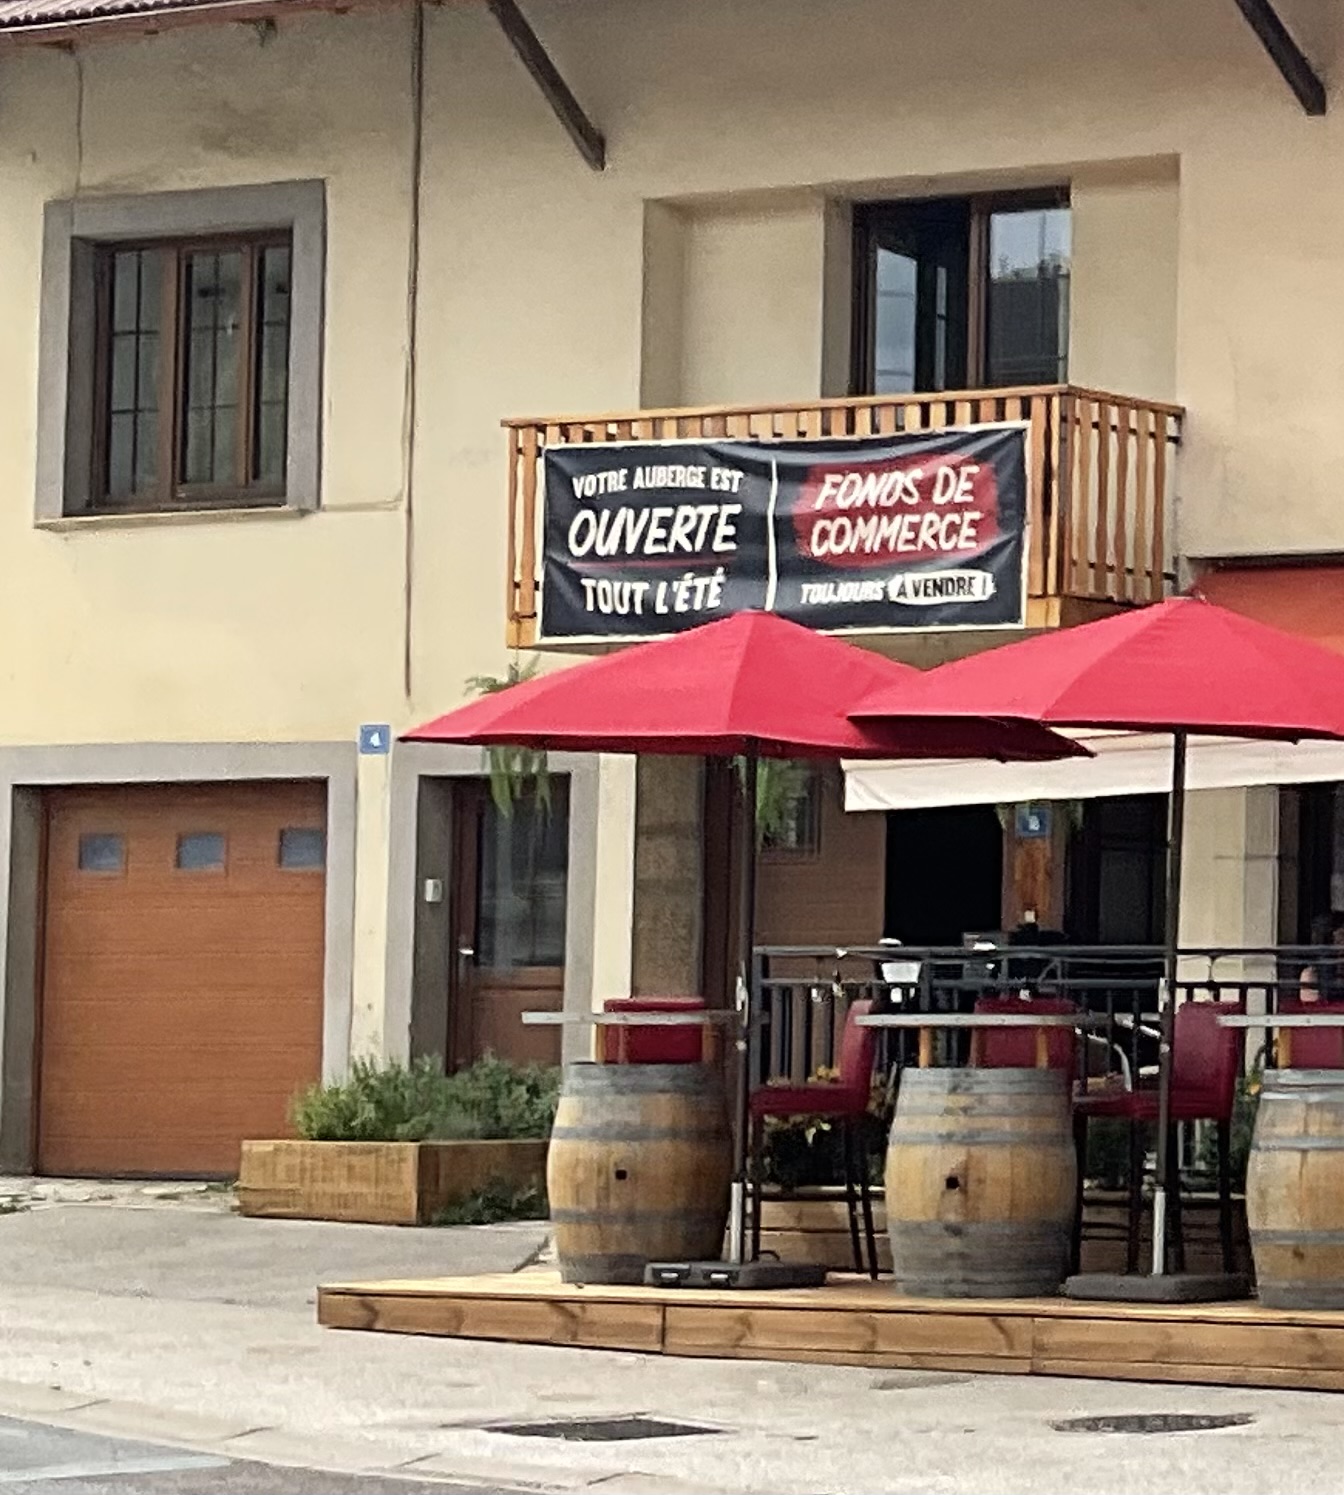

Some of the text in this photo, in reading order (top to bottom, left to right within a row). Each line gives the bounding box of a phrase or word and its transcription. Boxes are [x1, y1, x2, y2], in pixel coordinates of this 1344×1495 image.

[572, 465, 744, 499] VOTRE AUBERGE EST
[812, 465, 980, 510] FONDS DE
[568, 503, 742, 557] OUVERTE
[810, 510, 984, 557] COMMERCE
[581, 566, 728, 615] TOUT L'ÉTÉ
[800, 580, 886, 605] TOUJOURS
[911, 576, 977, 597] VENDRE
